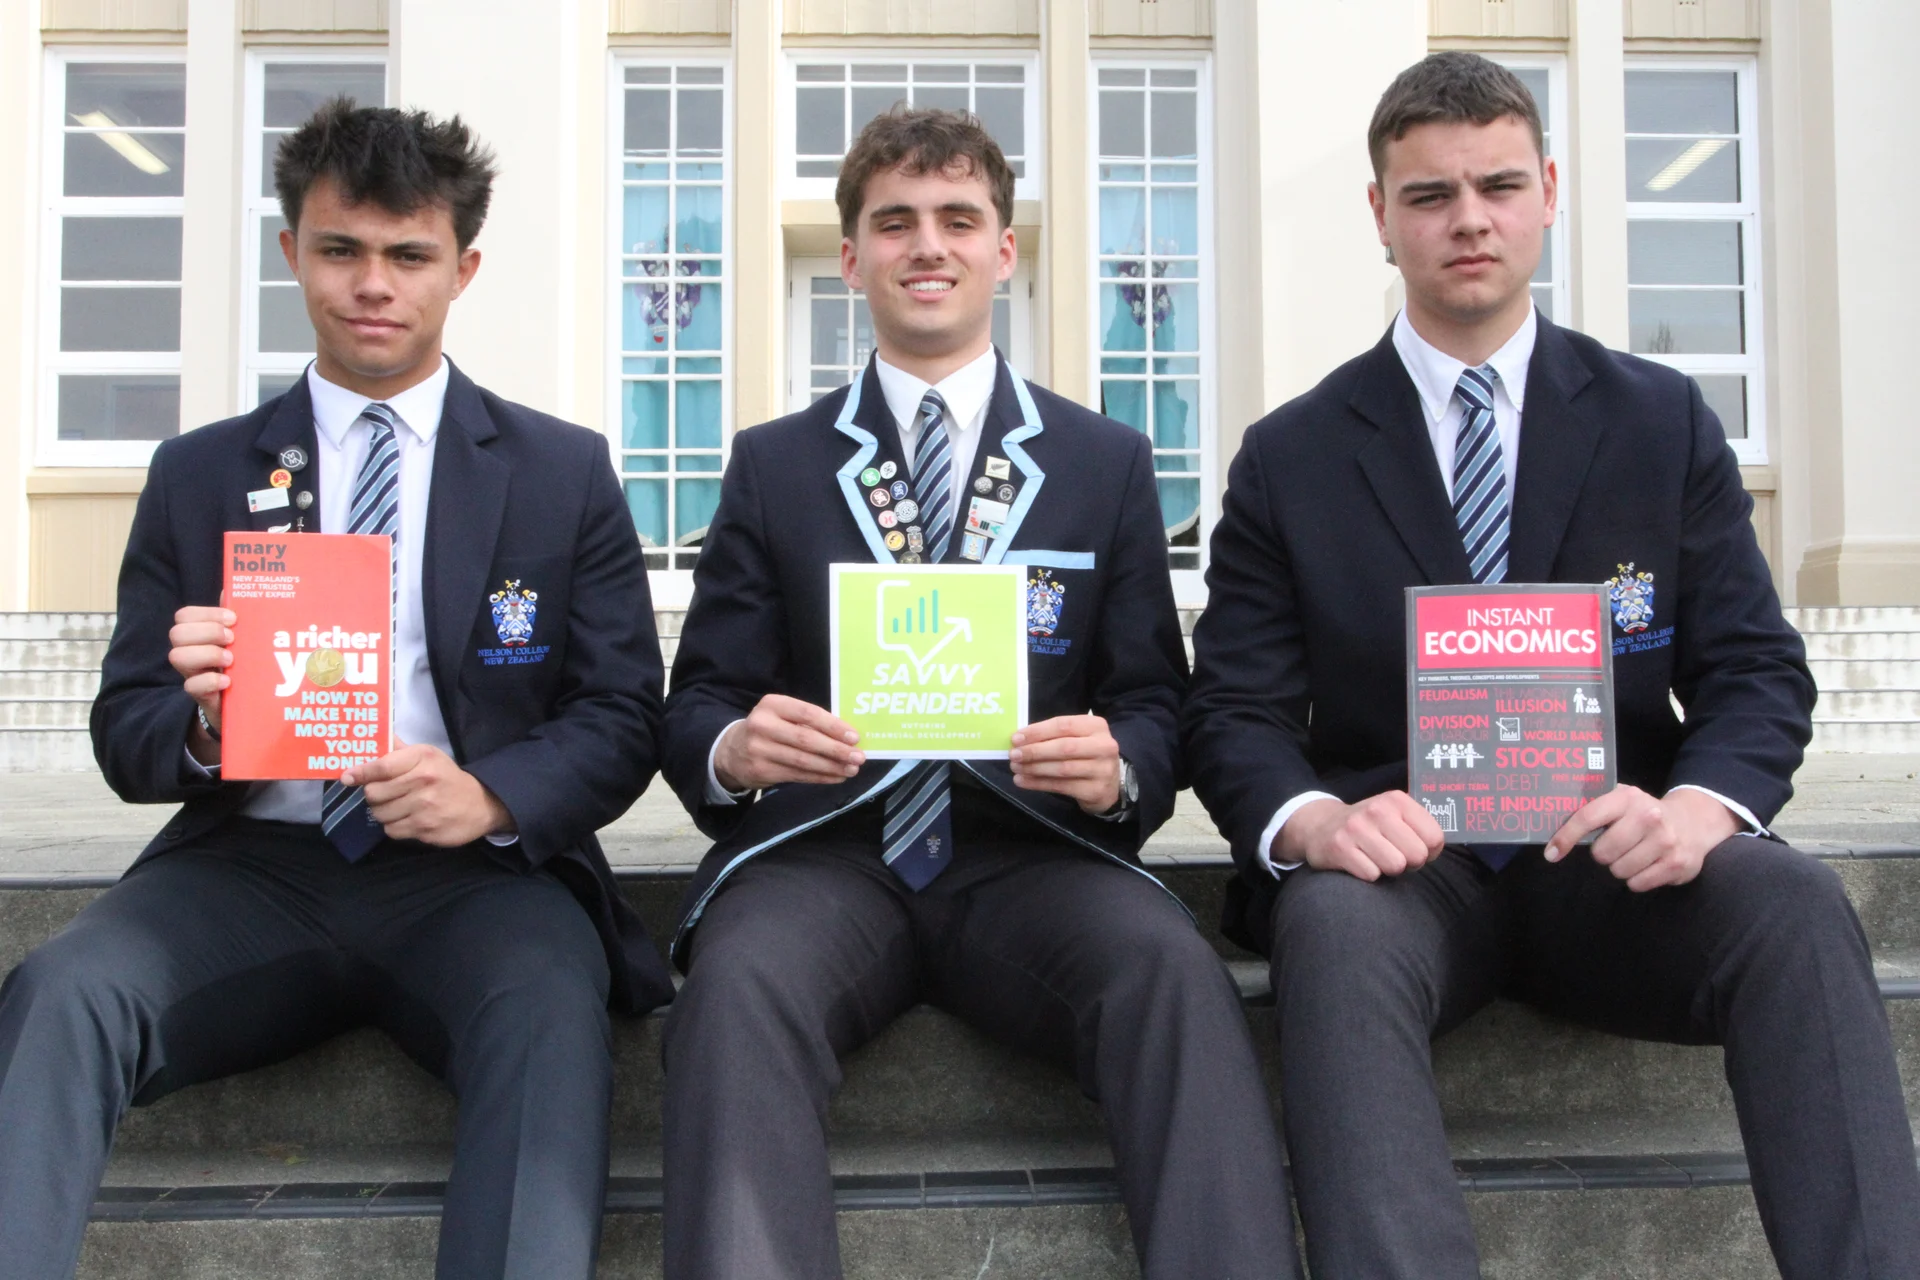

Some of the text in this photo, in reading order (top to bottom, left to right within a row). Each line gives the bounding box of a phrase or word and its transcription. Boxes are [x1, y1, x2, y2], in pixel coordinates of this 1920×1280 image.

[233, 543, 287, 559] mary
[233, 557, 286, 572] holm
[232, 575, 300, 583] NEW ZEALAND'S
[258, 583, 294, 591] TRUSTED
[265, 591, 296, 599] EXPERT
[1467, 608, 1554, 627] INSTANT
[273, 624, 382, 649] a richer
[1425, 629, 1597, 655] ECONOMICS
[1612, 625, 1675, 646] SON COLLEGE
[477, 648, 513, 657] NELSON
[1612, 636, 1671, 656] EW ZEALAND
[484, 654, 544, 665] NEW ZEALAND
[274, 649, 378, 697] you
[872, 662, 983, 687] SAVVY
[301, 691, 379, 706] HOW TO
[1419, 688, 1488, 702] FEUDALISM
[1495, 699, 1567, 713] ILLUSION
[284, 707, 379, 721] MAKE THE
[1419, 714, 1489, 730] DIVISION
[295, 723, 379, 738] MOST OF
[865, 731, 982, 740] FINANCIAL DEVELOPMENT
[1523, 730, 1604, 741] WORLD BANK
[324, 739, 378, 754] YOUR
[1495, 746, 1585, 769] STOCKS
[1421, 783, 1490, 792] THE SHORT TERM
[1496, 773, 1541, 791] DEBT
[1464, 796, 1596, 812] THE INDUSTRIA
